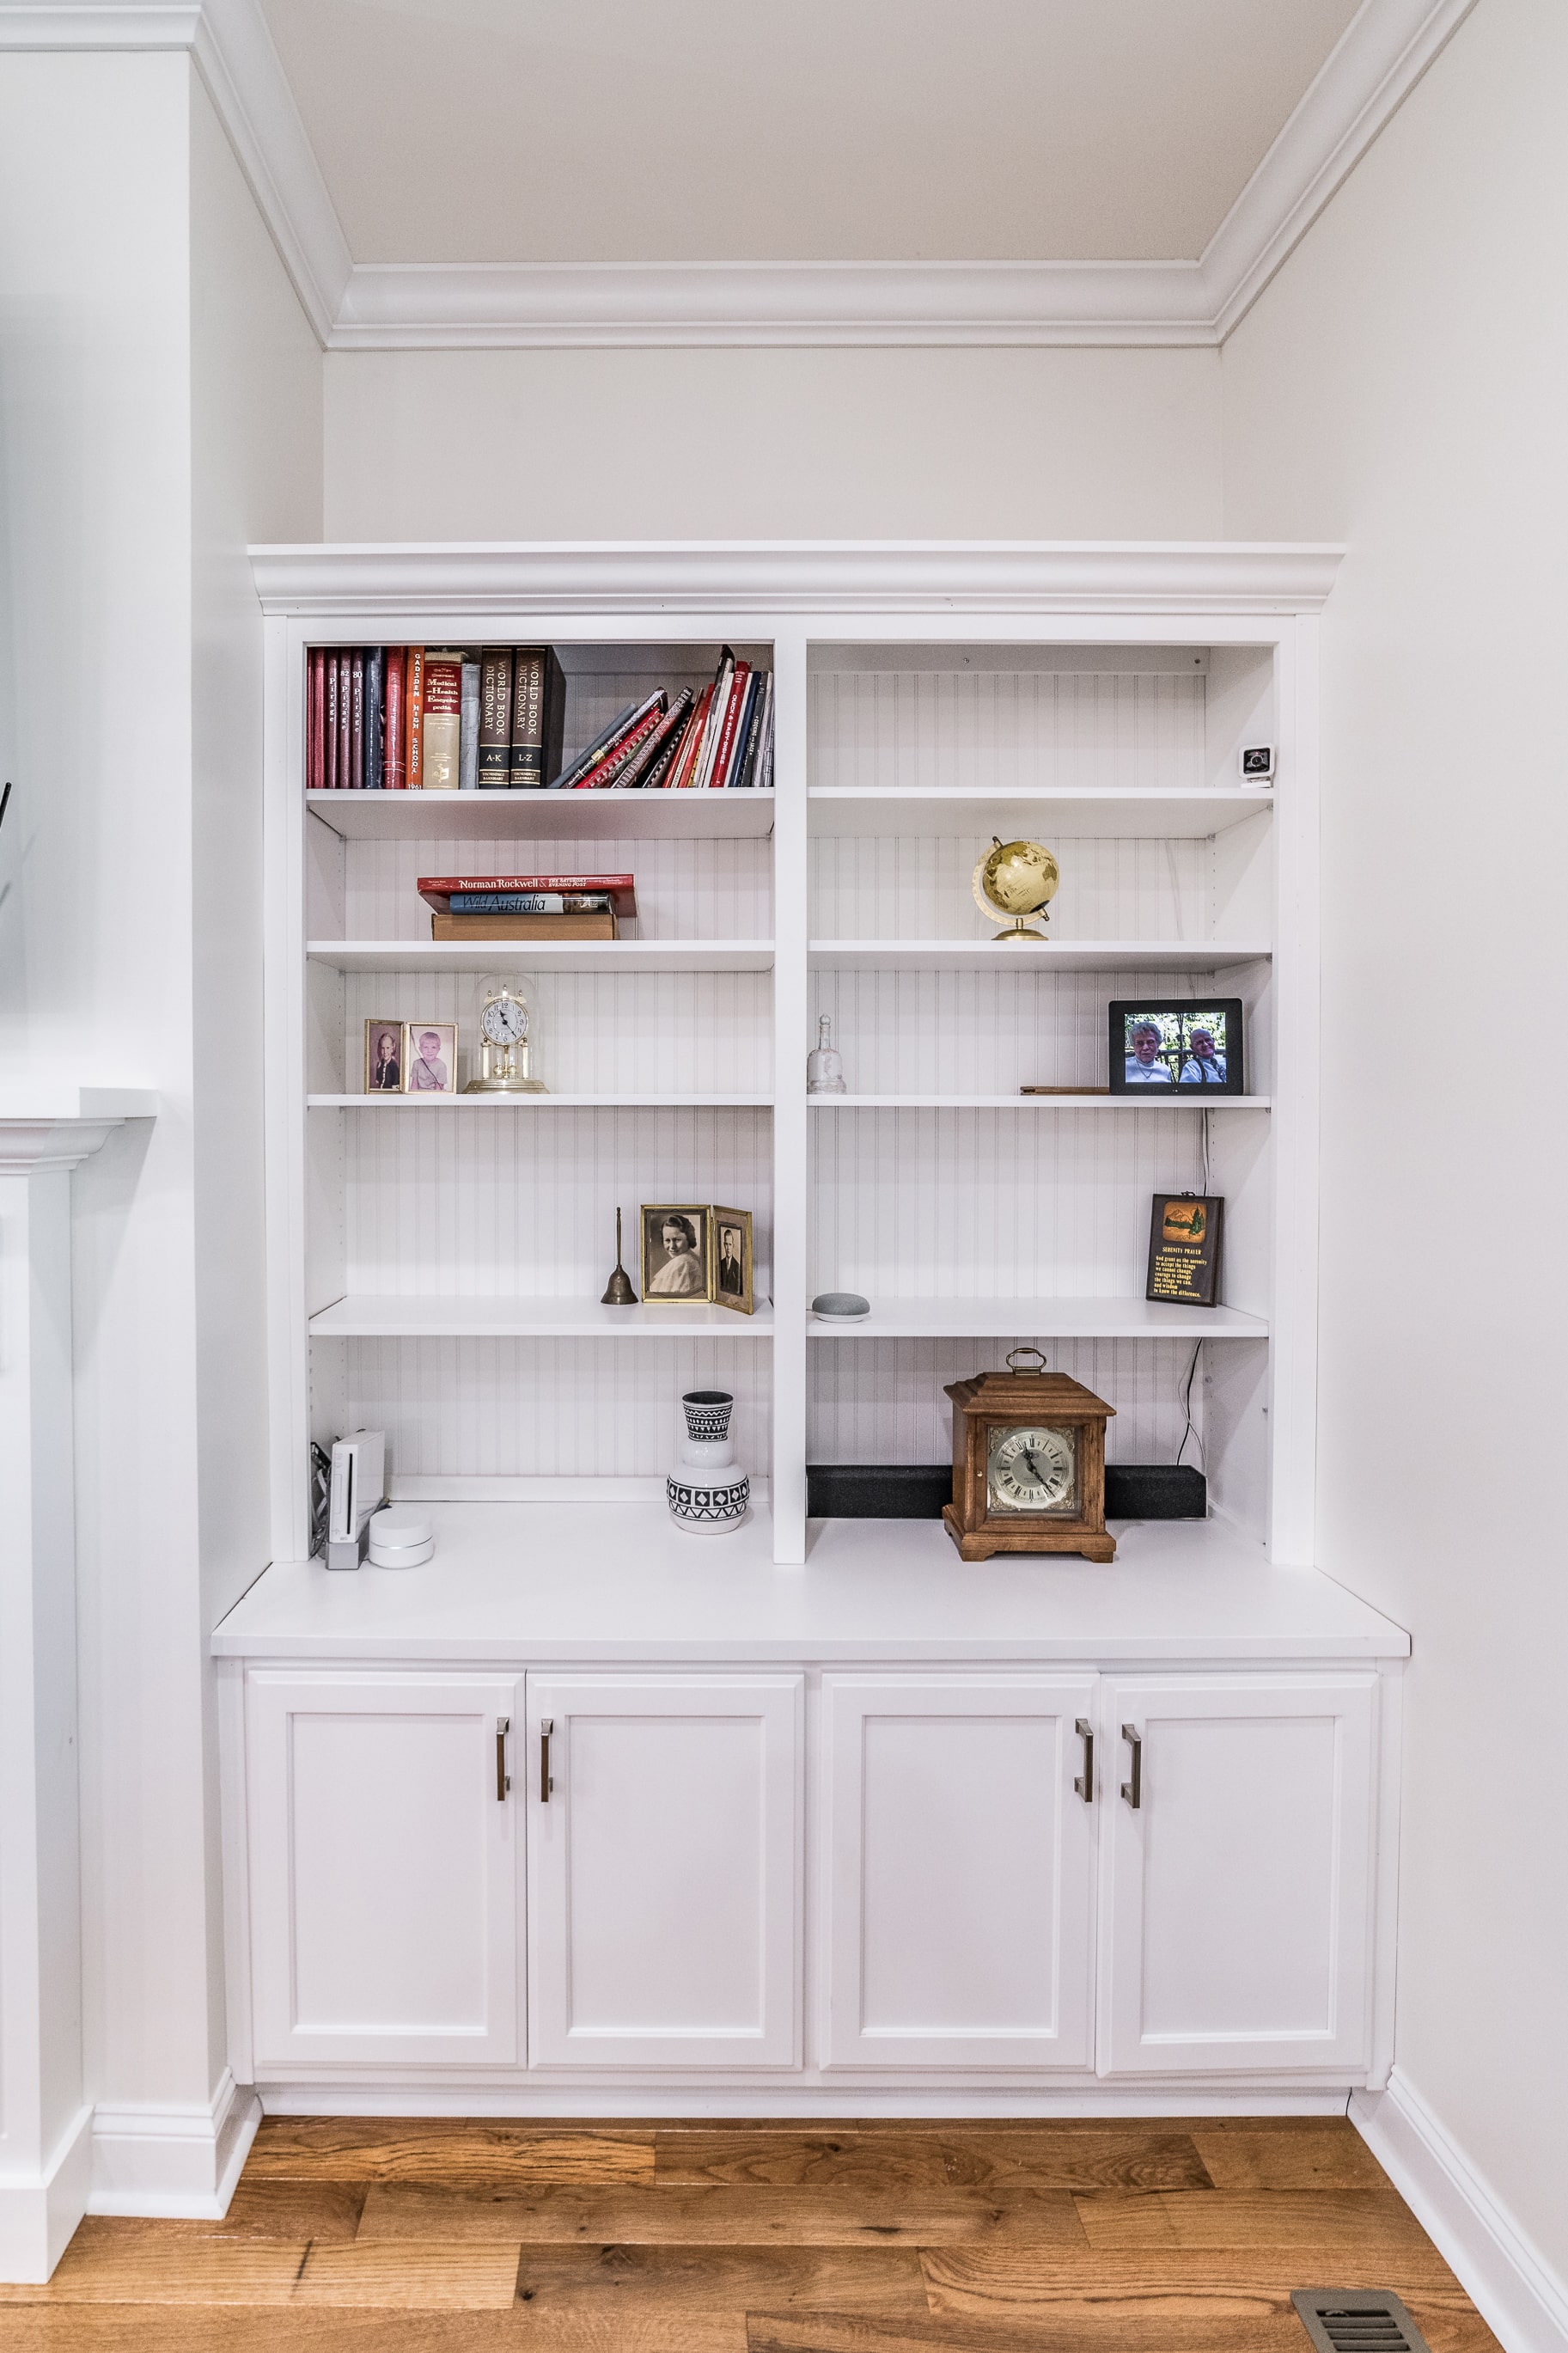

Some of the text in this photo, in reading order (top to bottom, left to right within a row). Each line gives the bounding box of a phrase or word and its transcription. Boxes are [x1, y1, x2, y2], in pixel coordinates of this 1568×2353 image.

[427, 678, 457, 687] Medical
[485, 665, 495, 730] DICTIONARY
[496, 661, 506, 735] WORLD BOOK
[516, 665, 528, 730] DICTIONARY
[528, 660, 540, 735] WORLD BOOK
[729, 694, 737, 715] QUICK
[486, 754, 502, 762] A-K
[458, 880, 497, 889] Norman
[497, 878, 539, 889] Rockwell
[464, 895, 546, 912] Wild Australia
